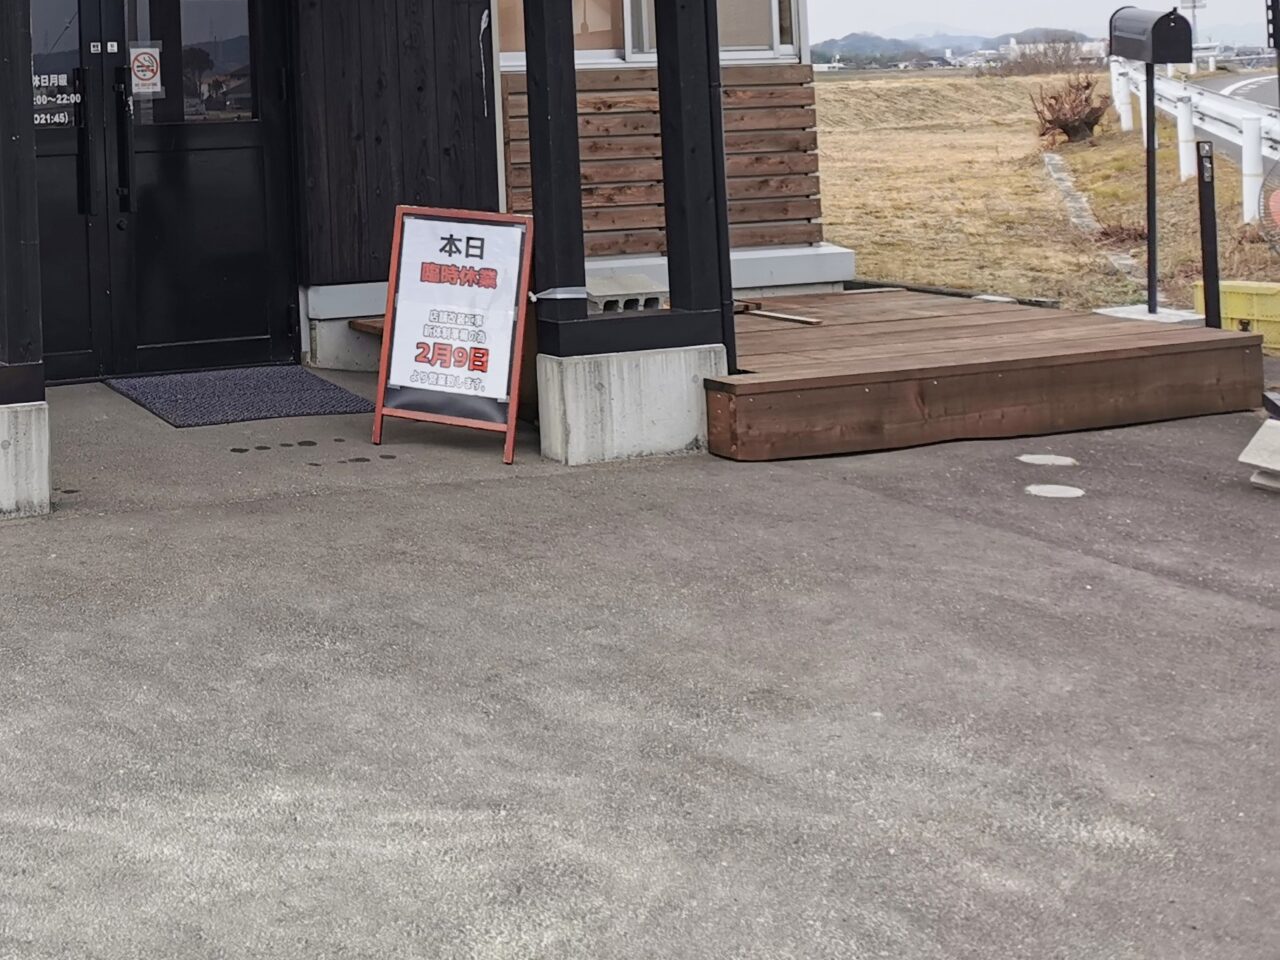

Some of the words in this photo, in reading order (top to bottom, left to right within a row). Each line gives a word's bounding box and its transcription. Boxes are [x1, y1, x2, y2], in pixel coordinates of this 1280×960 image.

[439, 233, 485, 260] 本日
[420, 261, 498, 290] 臨時休業
[414, 341, 490, 373] 2月9日
